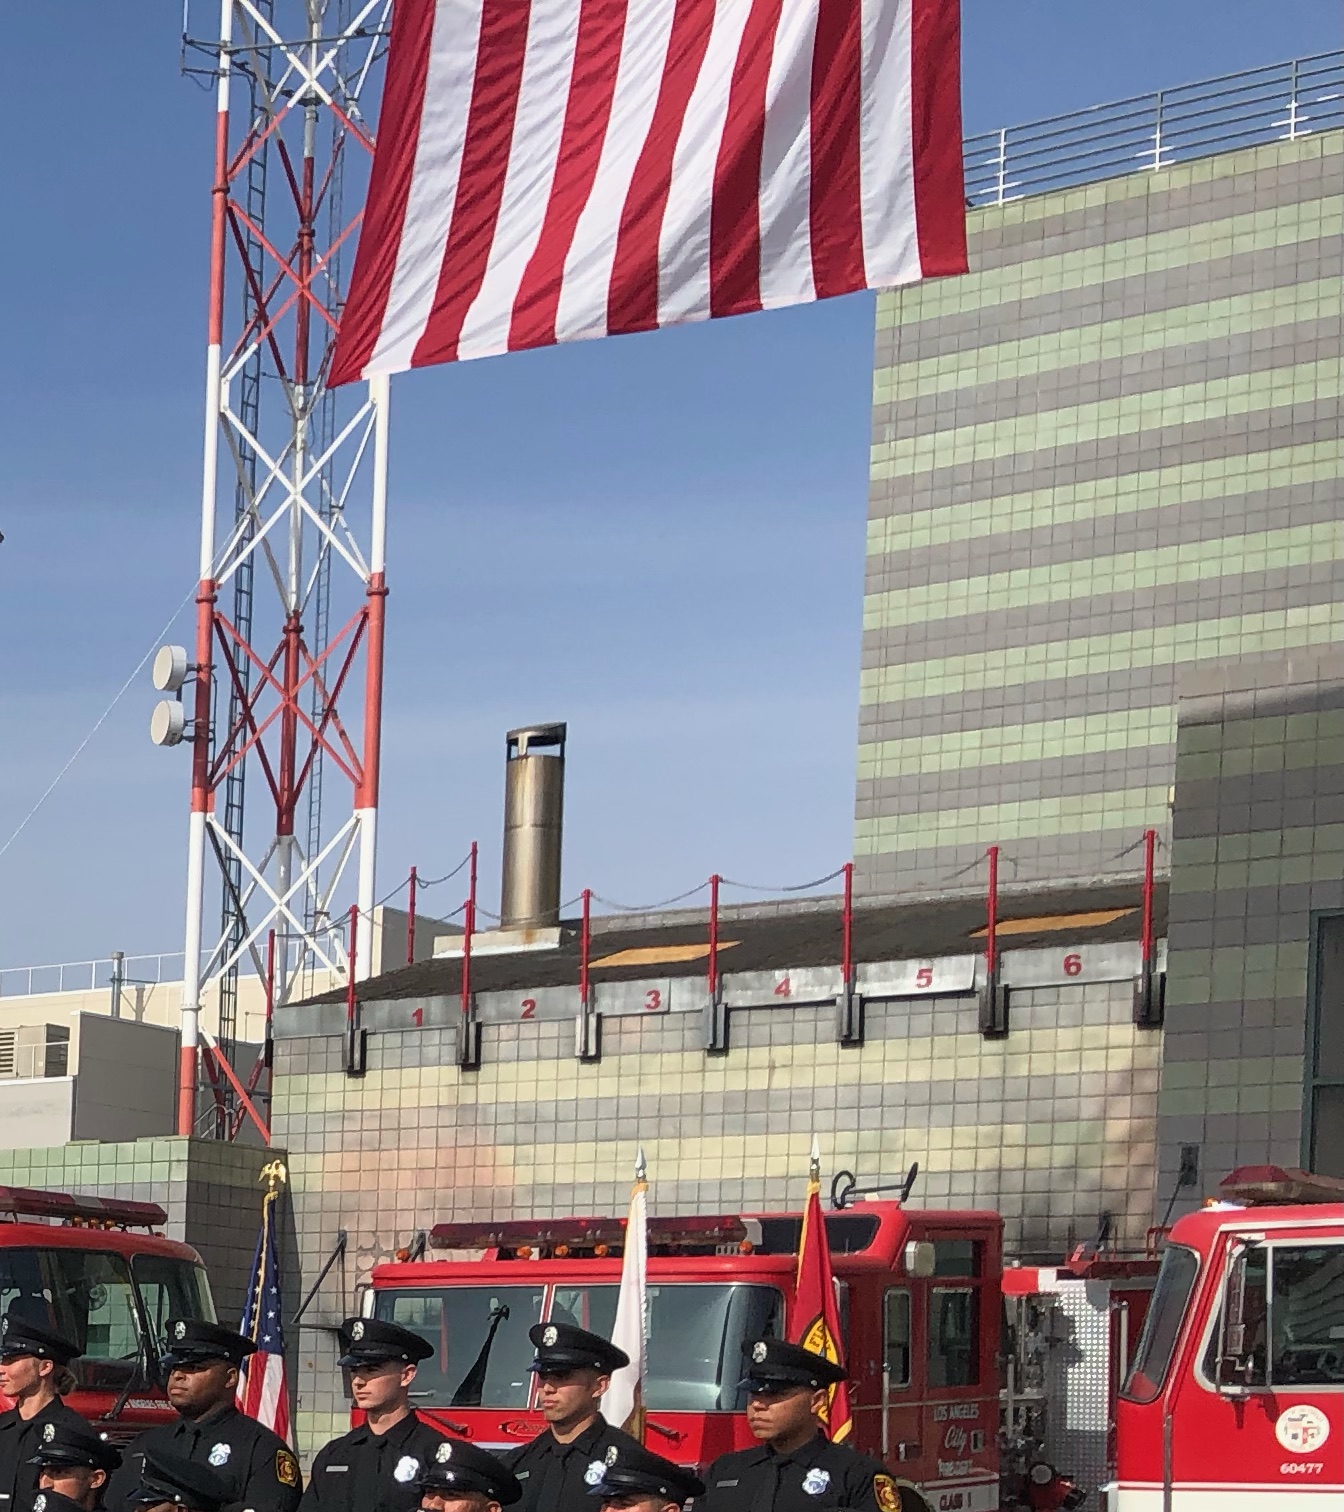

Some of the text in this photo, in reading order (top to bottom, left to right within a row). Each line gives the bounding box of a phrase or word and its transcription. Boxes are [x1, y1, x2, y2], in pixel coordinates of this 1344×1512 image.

[1062, 954, 1083, 977] 6
[773, 977, 793, 998] 4
[915, 967, 934, 990] 5
[520, 998, 537, 1019] 2
[645, 989, 662, 1010] 3
[412, 1007, 424, 1028] 1
[1279, 1462, 1324, 1475] 60477
